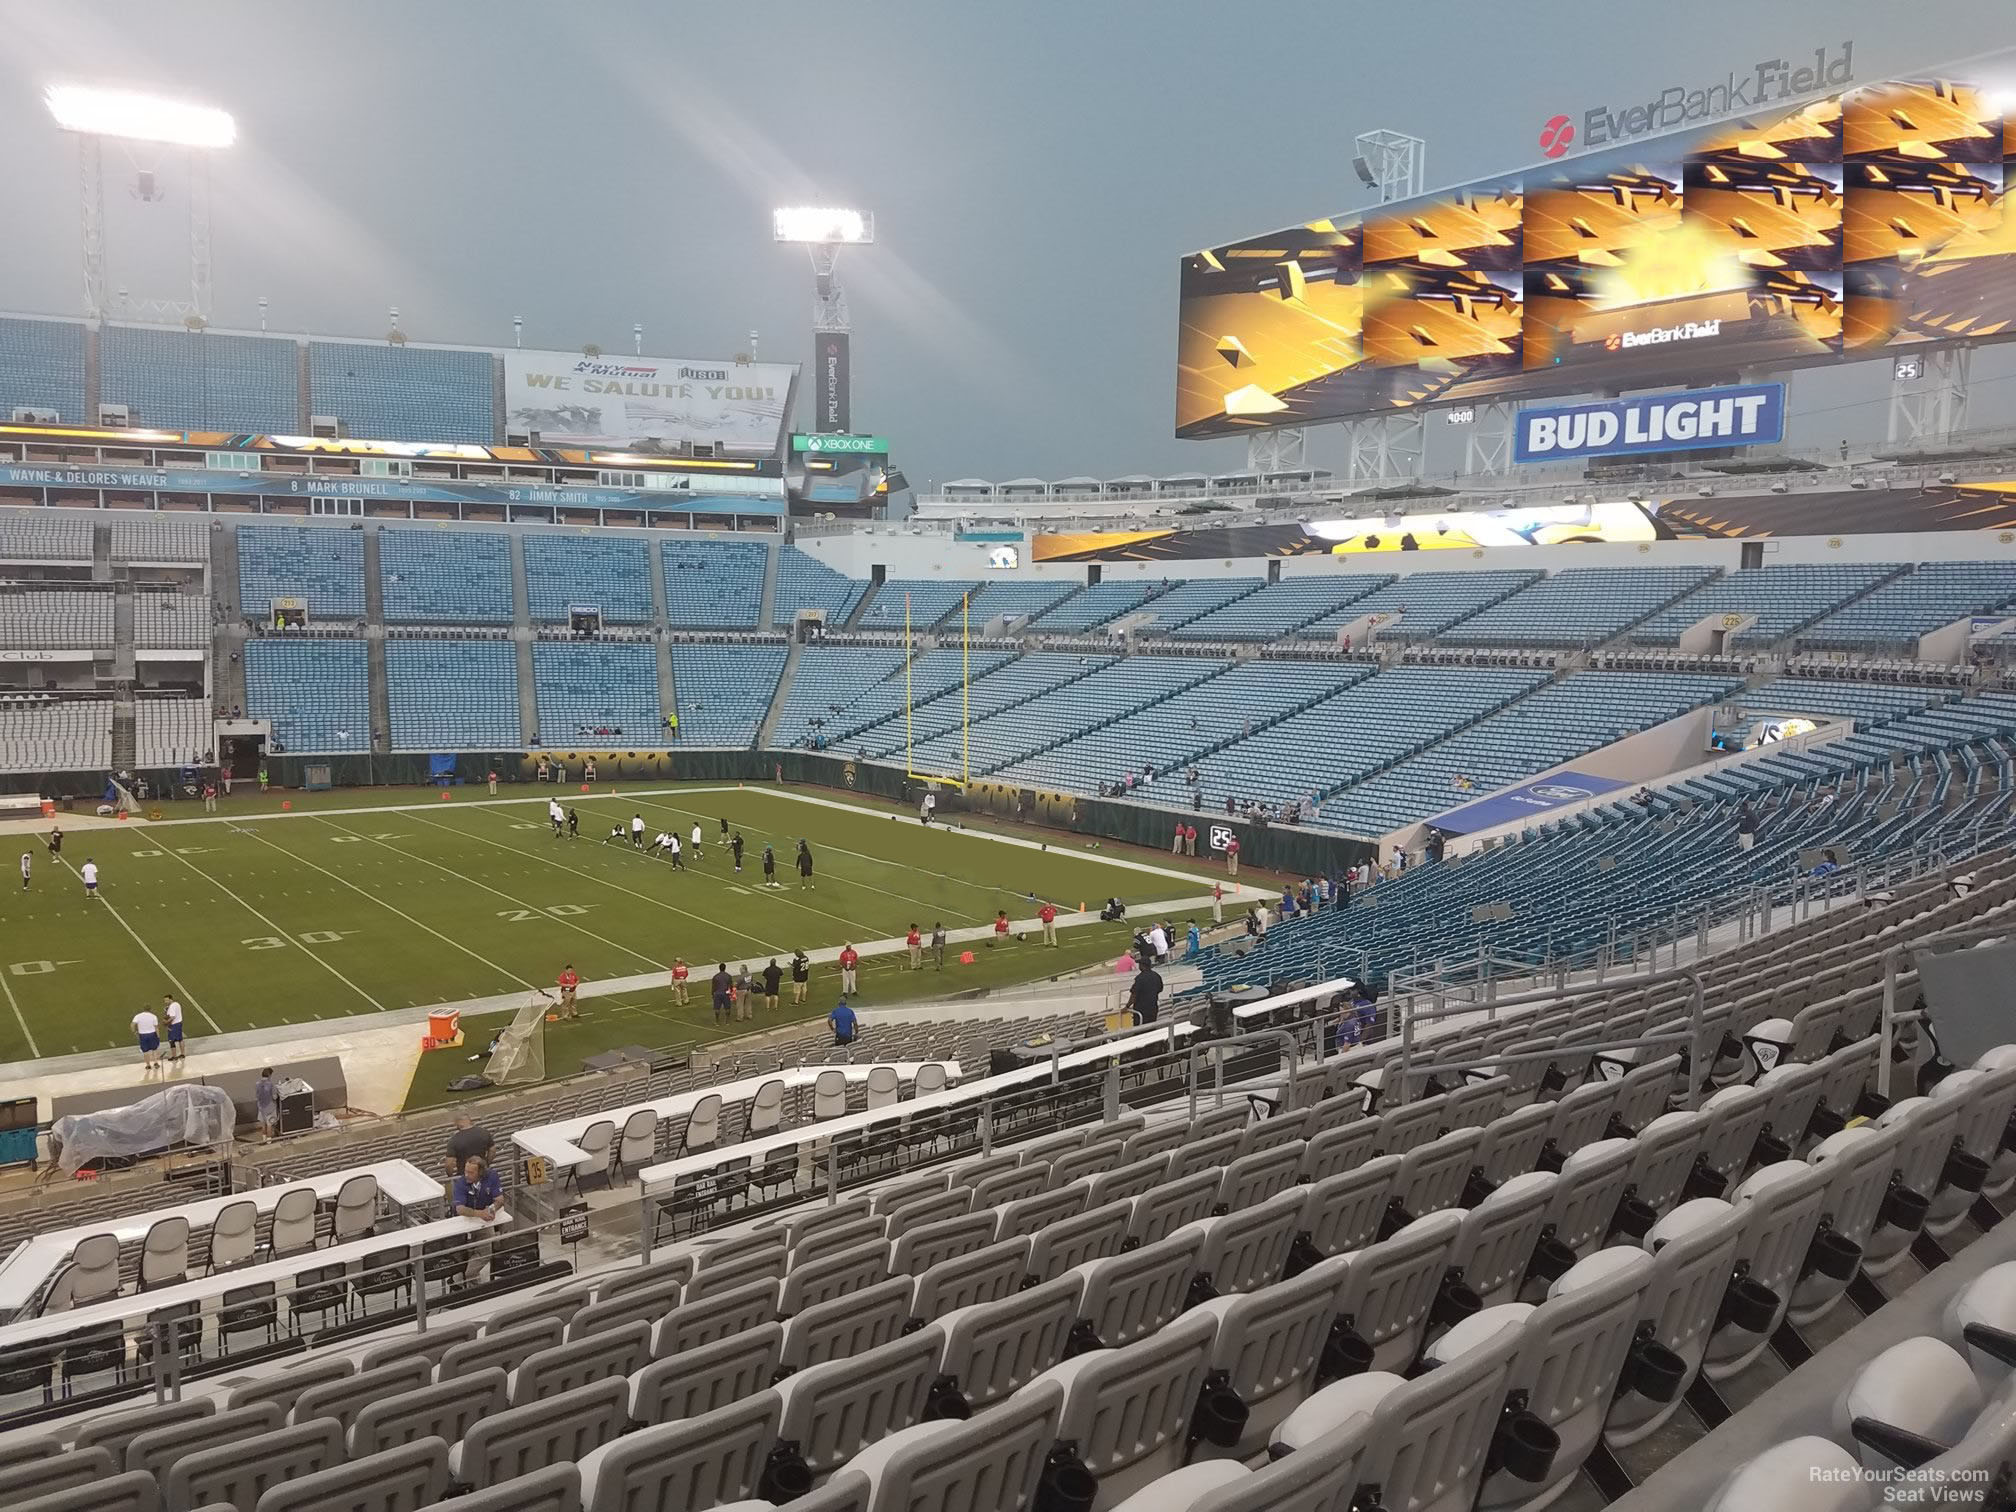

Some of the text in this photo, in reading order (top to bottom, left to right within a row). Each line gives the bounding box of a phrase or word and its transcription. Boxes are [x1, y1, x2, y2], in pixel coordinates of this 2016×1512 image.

[577, 361, 624, 371] Navy
[591, 368, 657, 378] Mutual
[1897, 363, 1917, 379] 25
[526, 373, 775, 401] WE SALUTE YOU!
[1528, 395, 1767, 452] BUD LIGHT
[10, 469, 51, 482] WAYNE
[55, 471, 63, 483] &
[67, 472, 118, 485] DELORES
[121, 474, 168, 487] WEAVER
[291, 480, 298, 492] 8
[307, 481, 339, 494] MARK
[341, 482, 388, 495] BRUNELL
[509, 490, 521, 501] 82
[528, 491, 558, 502] JIMMY
[560, 492, 588, 503] SMITH
[3, 651, 53, 660] Club
[1213, 829, 1230, 847] 25
[496, 903, 590, 922] 20
[241, 930, 344, 951] 30
[423, 1036, 436, 1049] 30
[531, 1161, 542, 1179] 35
[561, 1220, 588, 1236] ENTRANCE
